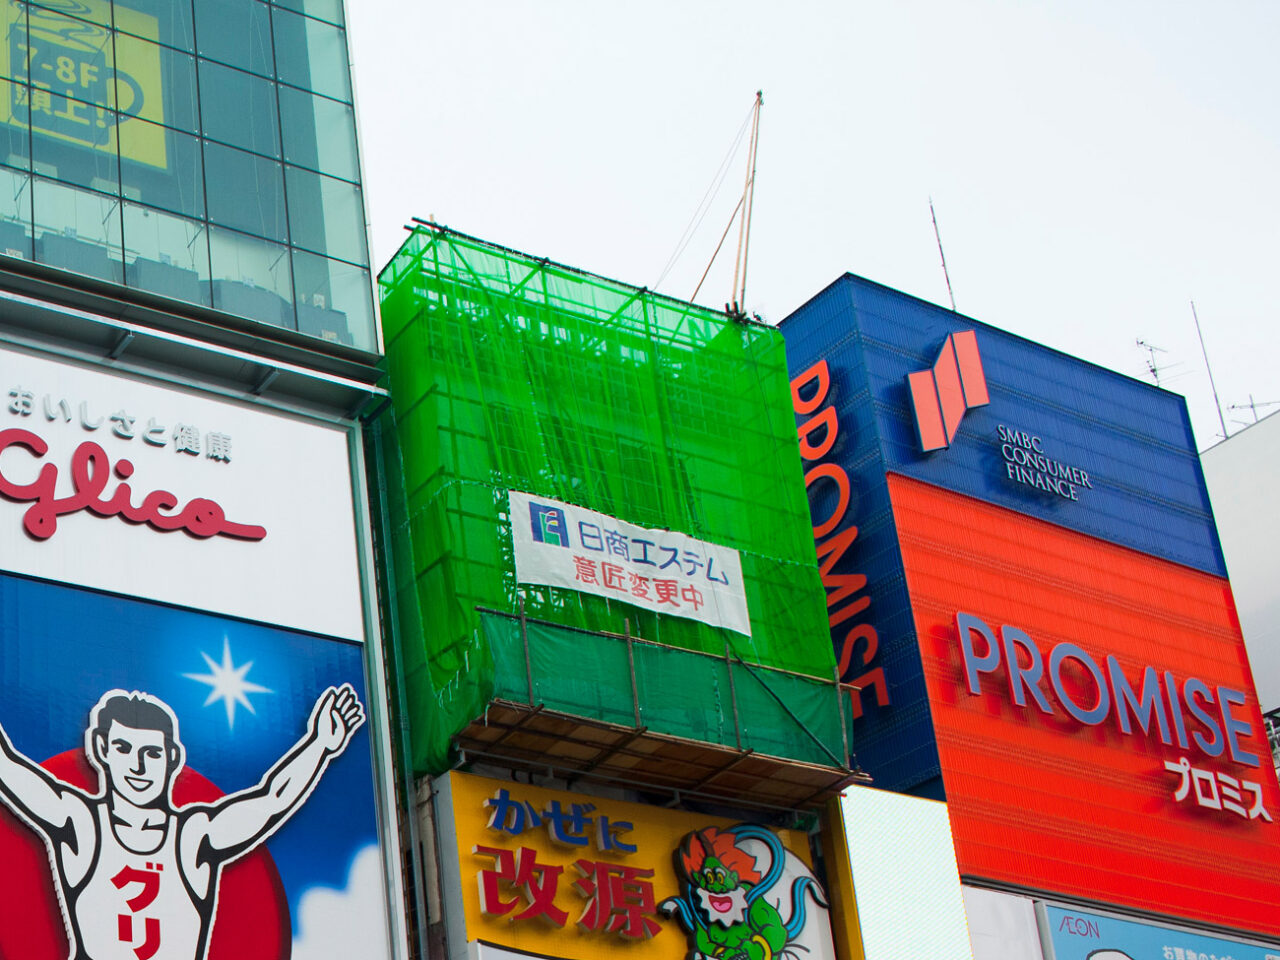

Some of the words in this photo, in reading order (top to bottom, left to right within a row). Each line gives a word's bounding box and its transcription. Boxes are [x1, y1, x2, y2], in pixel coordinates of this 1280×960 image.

[17, 43, 99, 88] 7-8F
[7, 385, 232, 463] おいしさと健康
[997, 424, 1044, 454] SMBC
[1001, 443, 1094, 489] CONSUMER
[1006, 462, 1078, 502] FINANCE
[572, 555, 704, 611] 意匠変更中
[577, 520, 729, 586] 日商エステム
[956, 610, 1260, 767] PROMISE
[483, 788, 638, 853] かぜに
[1164, 757, 1273, 823] プロミス
[472, 845, 663, 939] 改源
